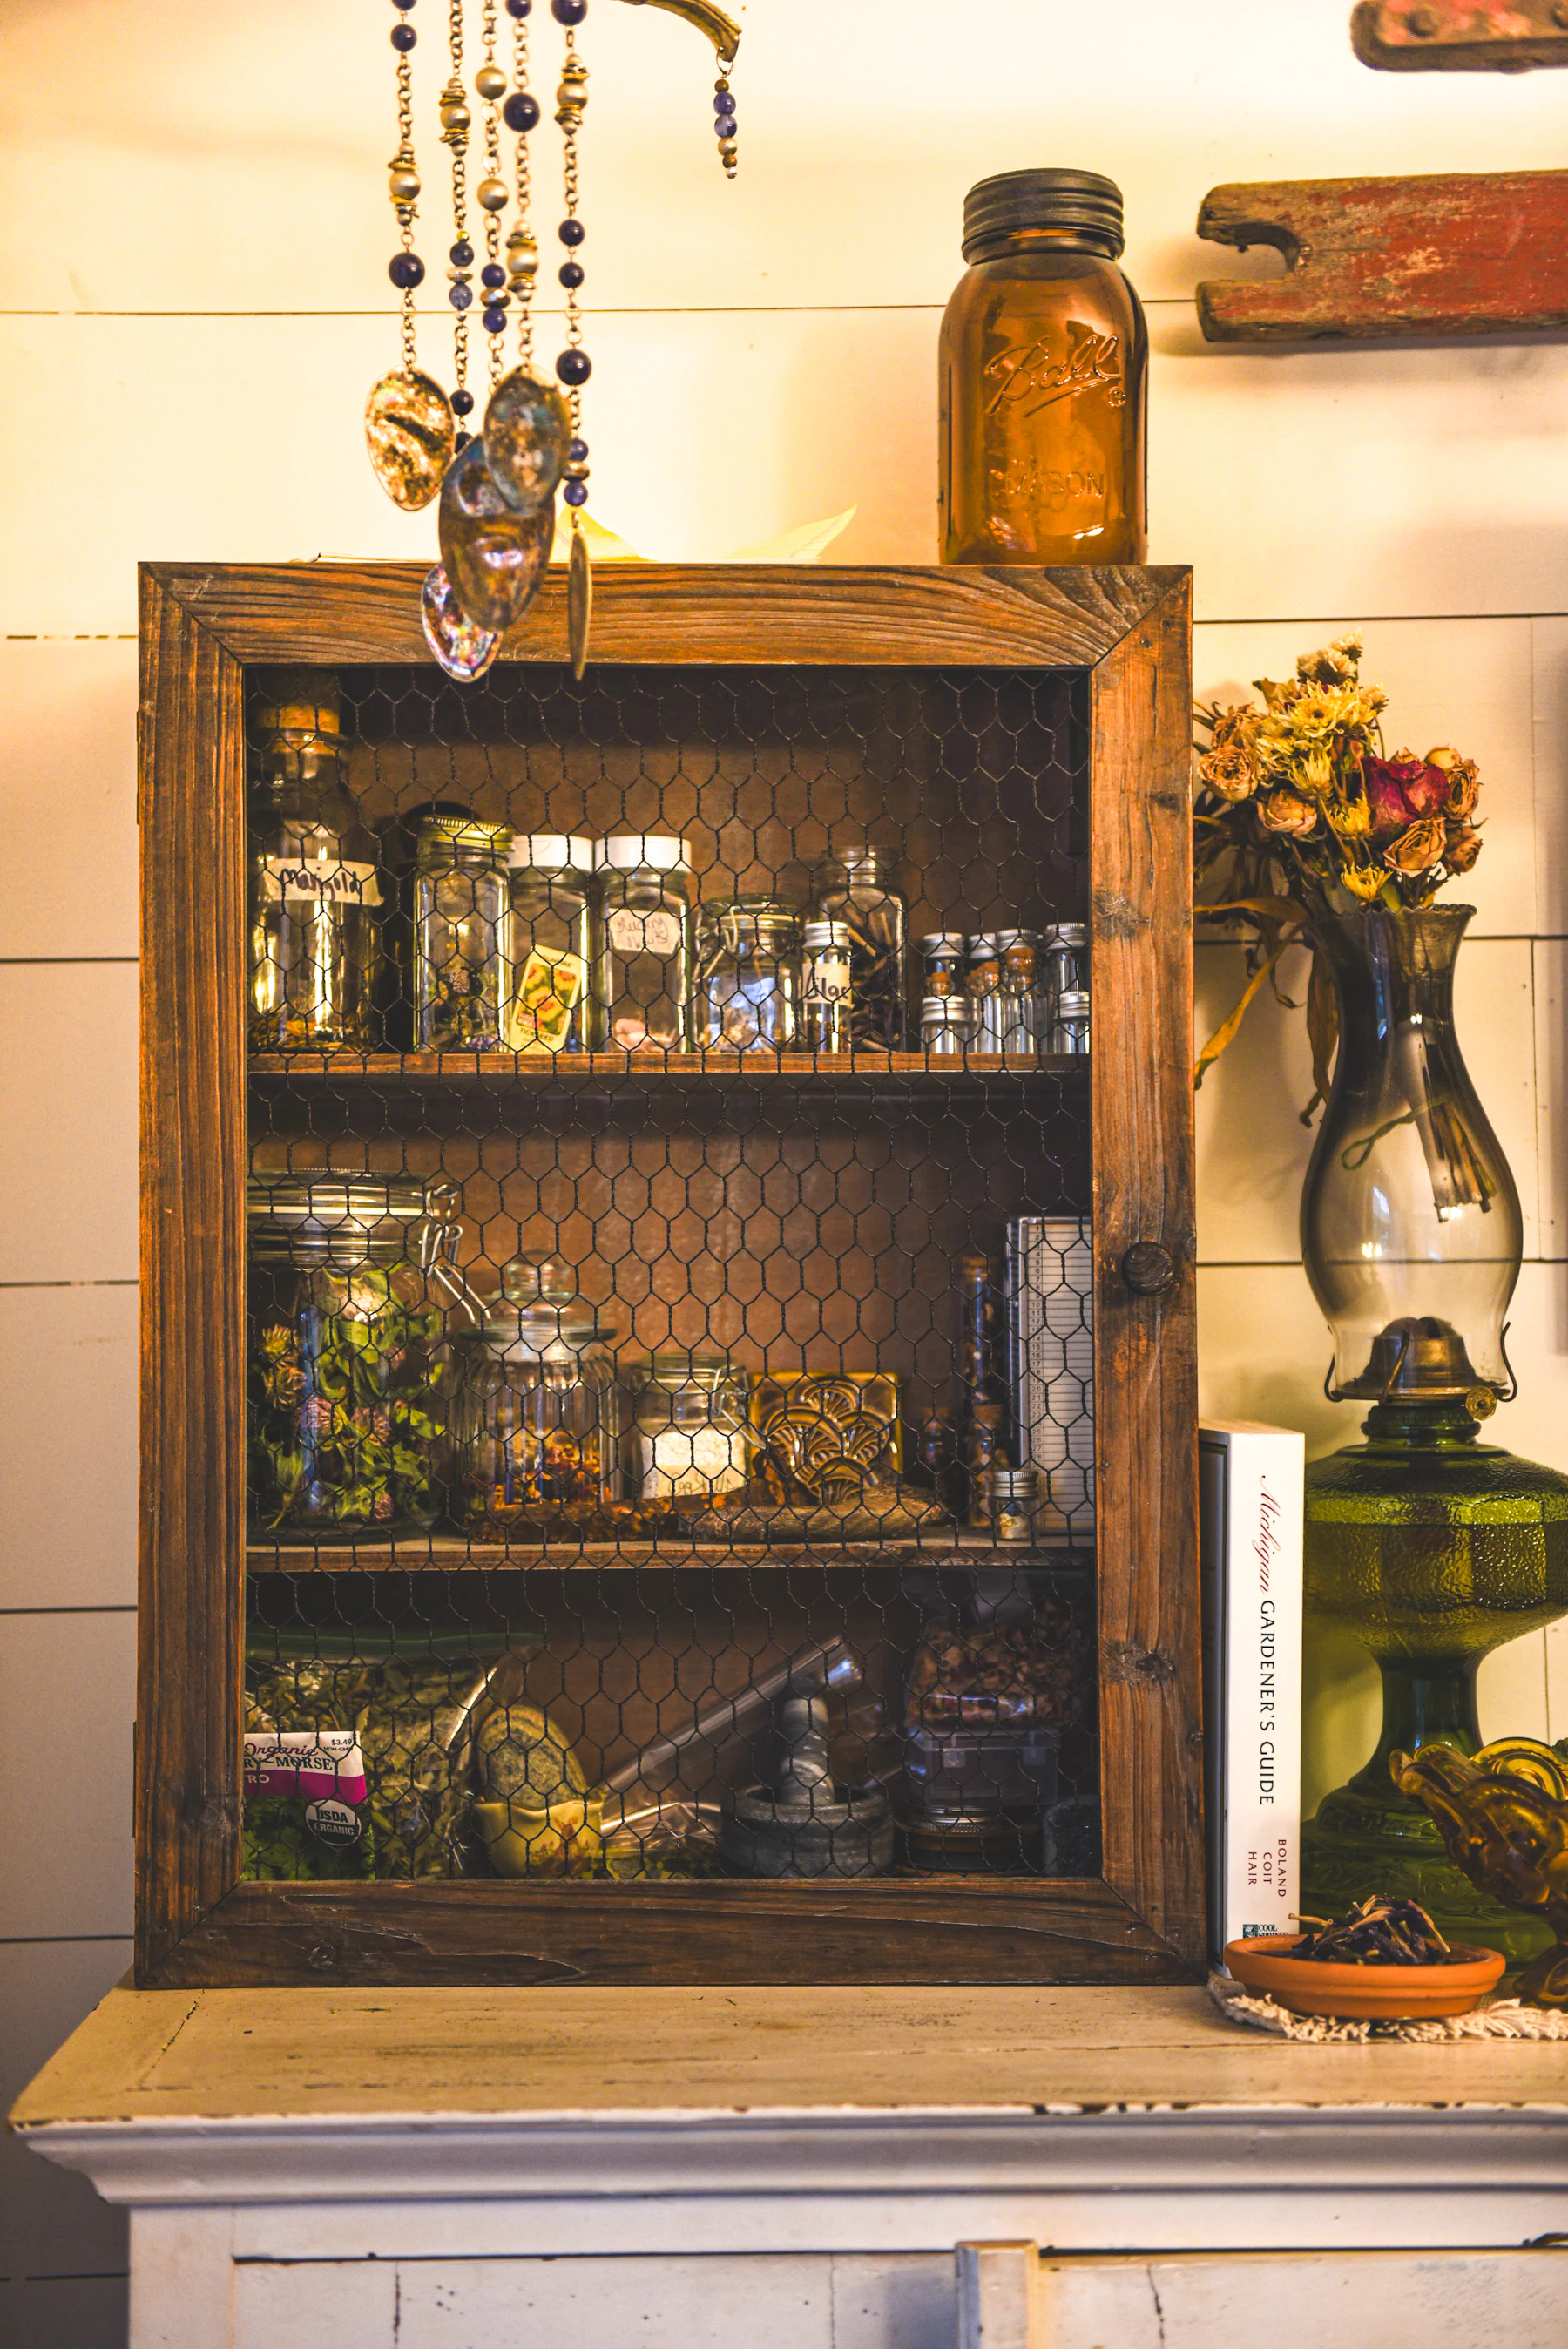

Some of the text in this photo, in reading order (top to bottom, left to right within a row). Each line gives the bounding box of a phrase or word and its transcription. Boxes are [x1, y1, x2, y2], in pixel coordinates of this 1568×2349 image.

[984, 335, 1123, 417] Ball
[1006, 470, 1105, 498] MASON
[519, 1027, 554, 1041] TICKEED
[1252, 1475, 1281, 1805] Michigan GARDENER'S GUIDE
[244, 1743, 319, 1759] Organic
[1247, 1851, 1257, 1885] HAIR
[1263, 1851, 1272, 1884] COIT
[1277, 1839, 1287, 1897] BOLAND
